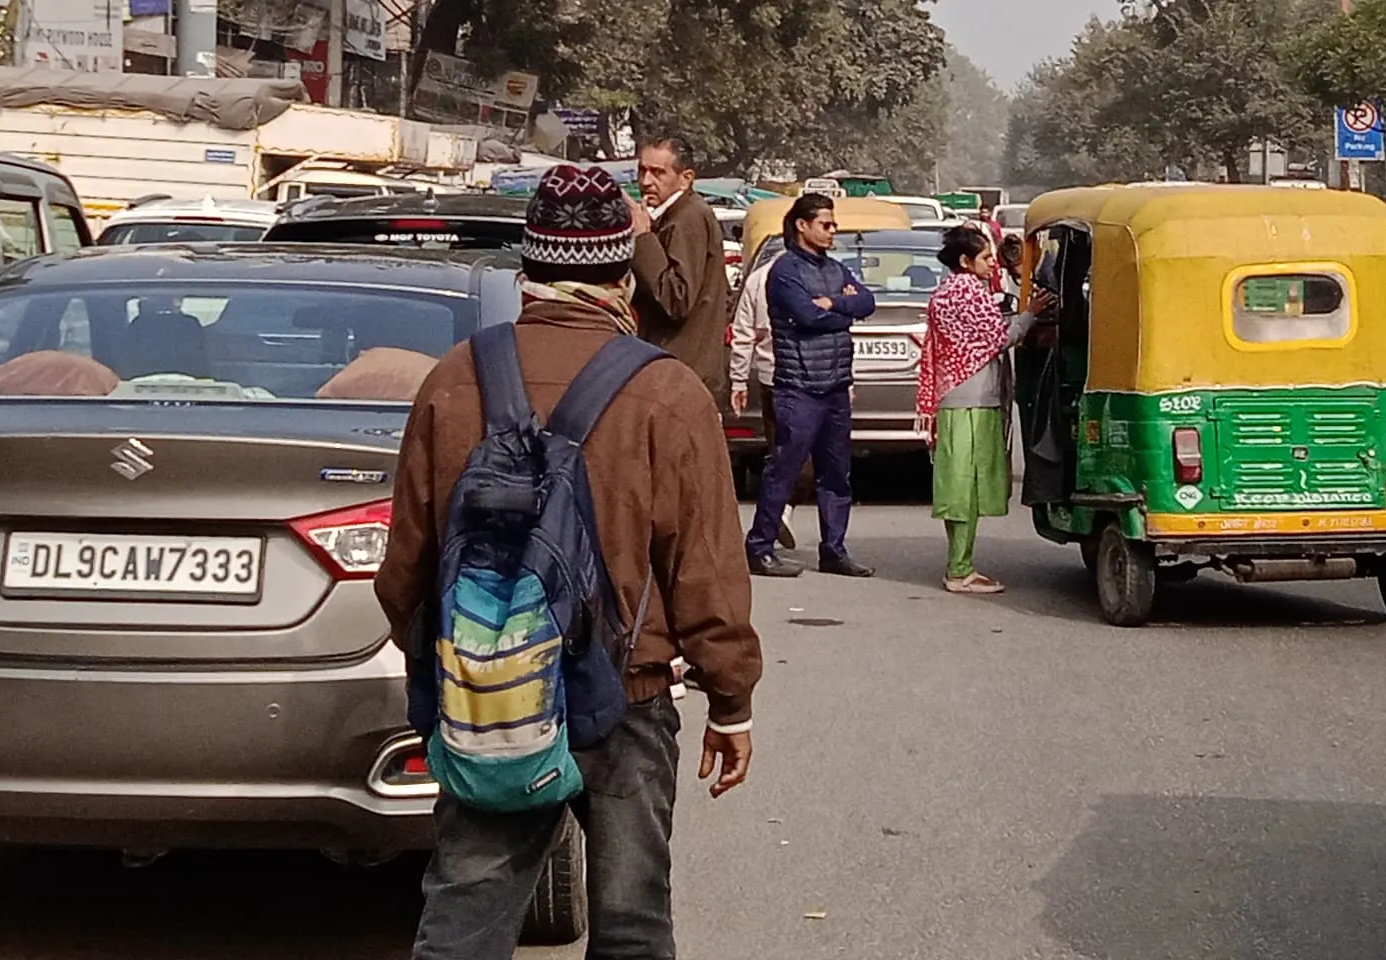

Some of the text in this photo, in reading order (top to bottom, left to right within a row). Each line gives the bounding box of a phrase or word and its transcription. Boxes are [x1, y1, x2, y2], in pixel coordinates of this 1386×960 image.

[1344, 142, 1376, 152] Parking
[416, 233, 460, 242] TOYOTA
[853, 341, 907, 356] AW5593
[30, 543, 255, 584] DL9CAW7333
